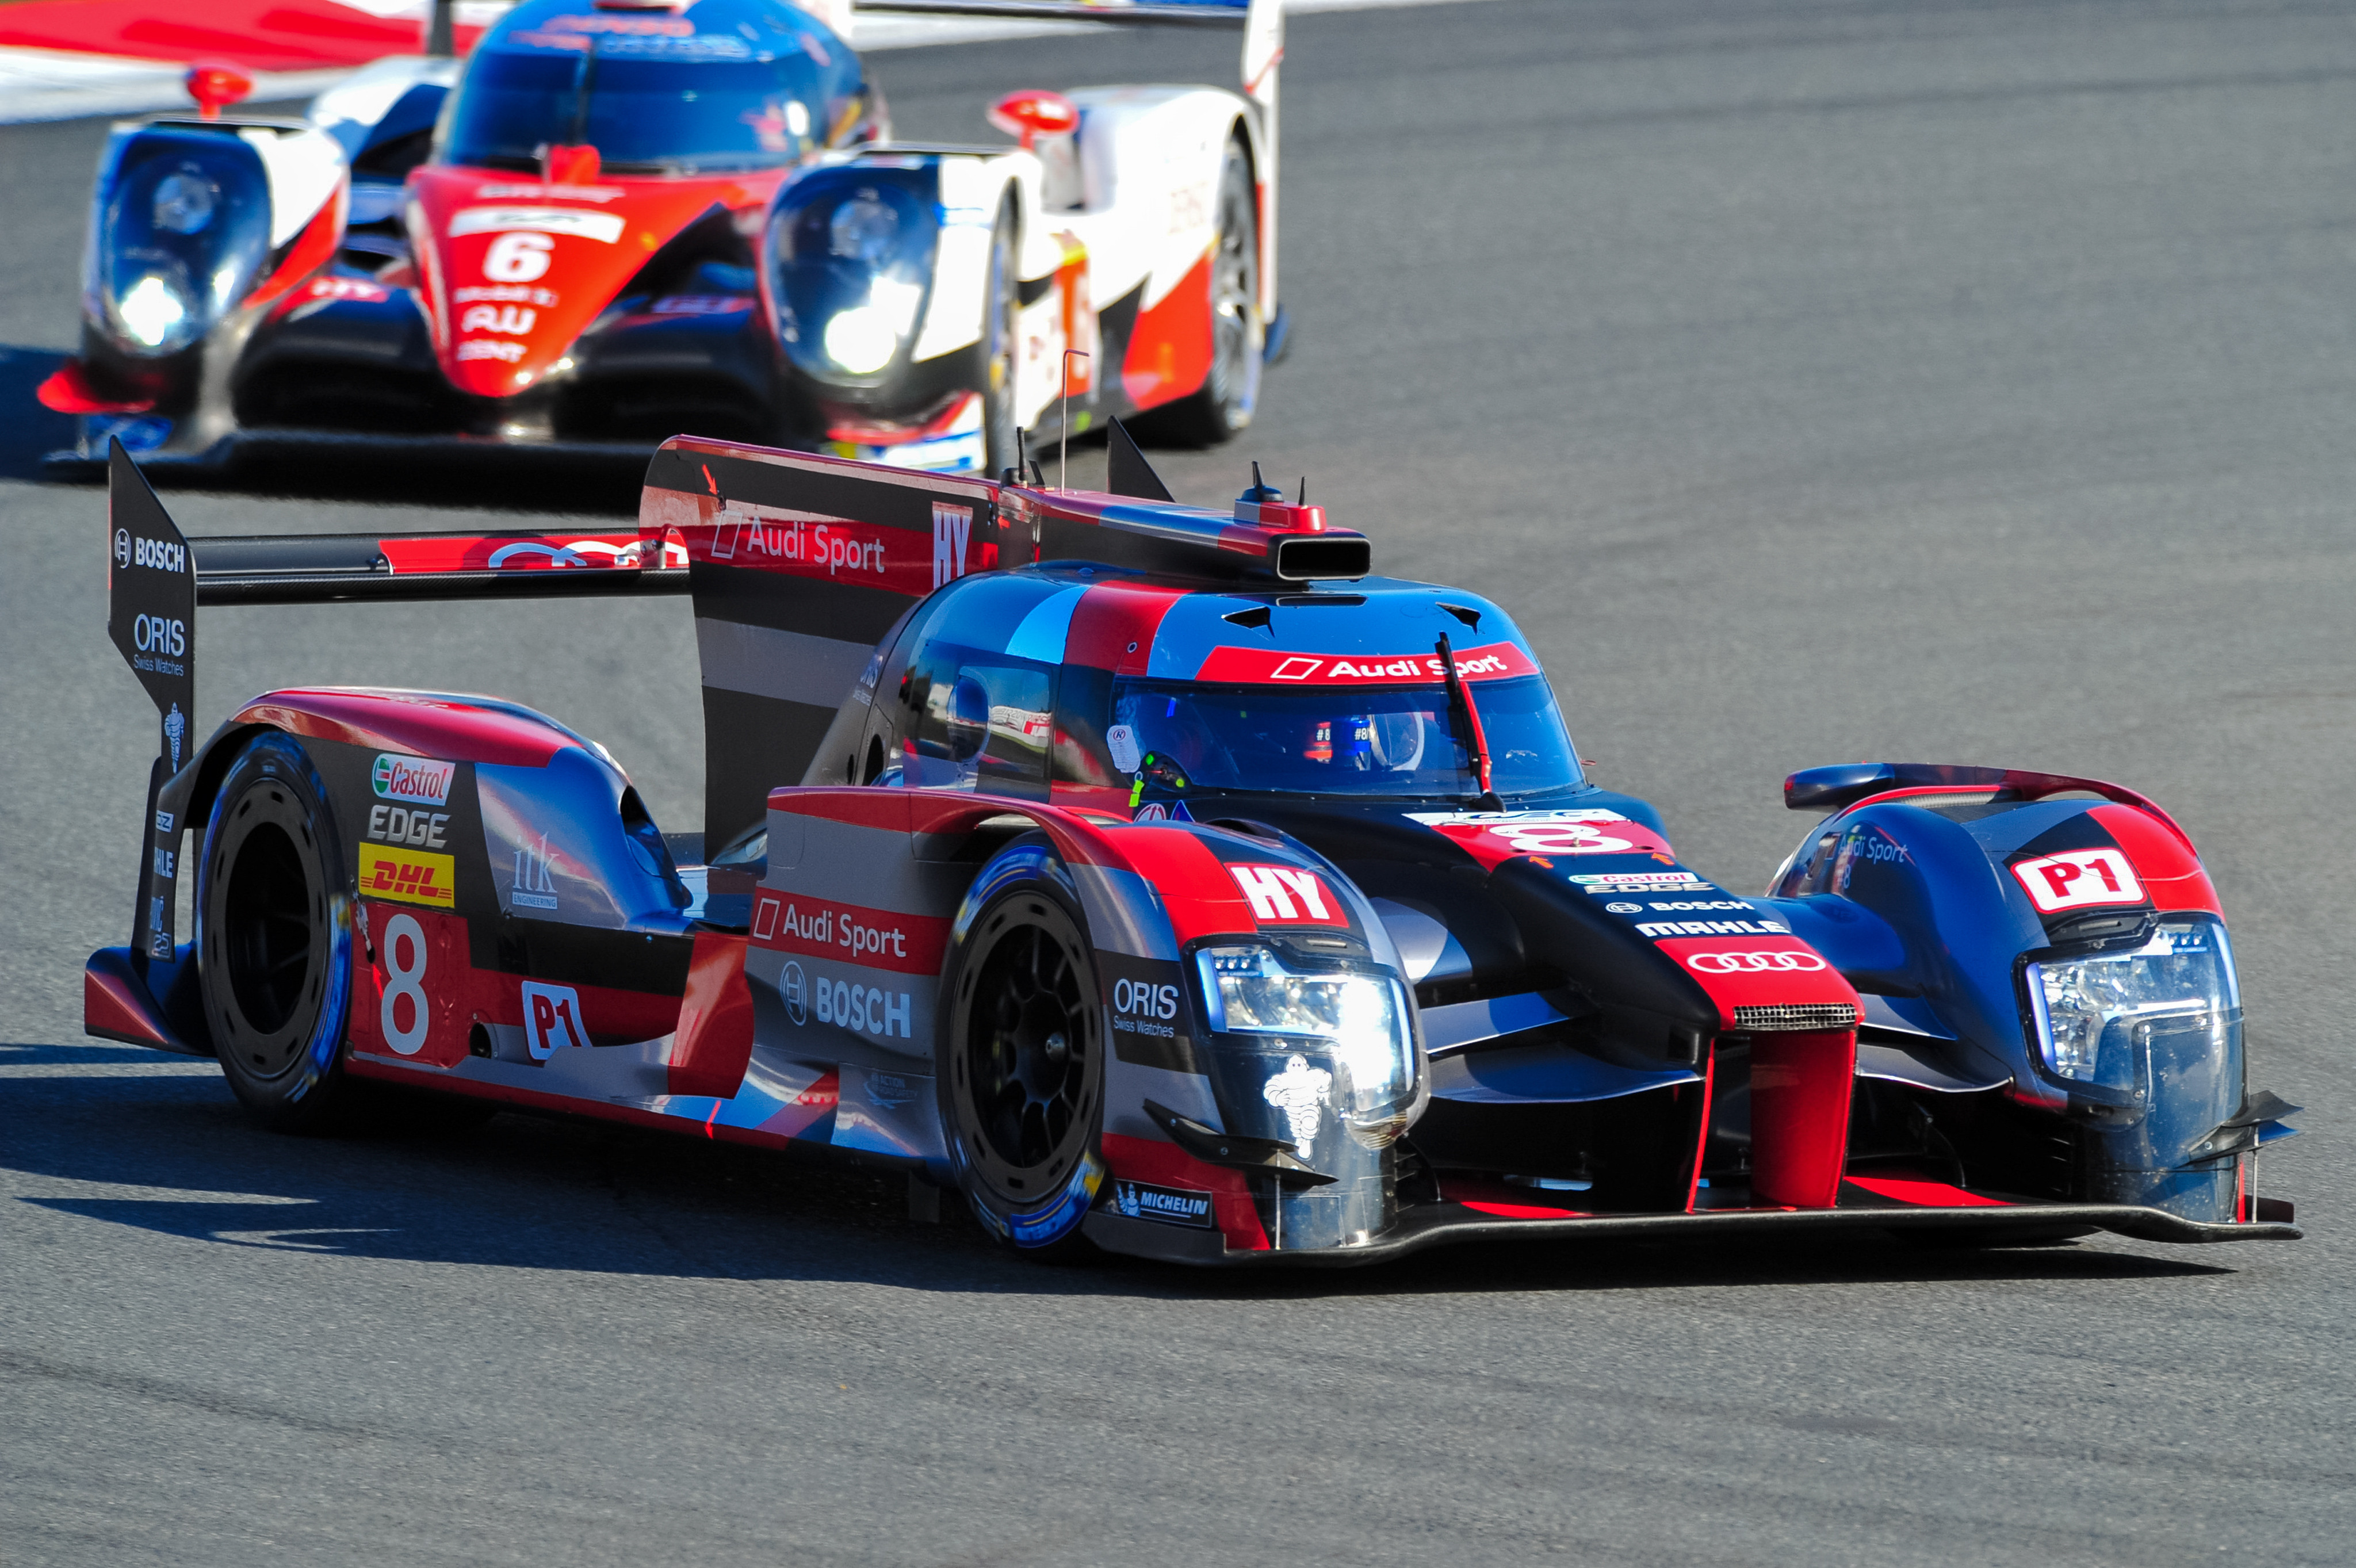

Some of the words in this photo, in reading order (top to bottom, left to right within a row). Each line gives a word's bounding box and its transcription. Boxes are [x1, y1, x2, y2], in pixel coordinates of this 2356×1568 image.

[481, 231, 555, 282] 6
[135, 537, 185, 573] BOSCH
[747, 516, 805, 560] Audi
[814, 525, 885, 575] Sport
[933, 511, 971, 589] HY
[134, 613, 185, 657] ORIS
[133, 654, 154, 672] Swiss
[155, 657, 184, 676] Watches
[1328, 660, 1421, 677] Audi
[1426, 655, 1508, 678] Sport
[390, 762, 448, 799] Castrol
[367, 805, 452, 849] EDGE
[1489, 823, 1633, 852] 8
[512, 832, 560, 893] itk
[1838, 833, 1865, 857] Audi
[1866, 836, 1908, 865] Sport
[372, 860, 439, 897] DHL
[1230, 867, 1330, 920] HY
[1584, 882, 1716, 894] EDGE
[1602, 874, 1686, 883] Castrol
[2038, 858, 2122, 898] P1
[513, 894, 556, 908] ENGINEERING
[1648, 901, 1755, 912] BOSCH
[783, 904, 832, 943] Audi
[839, 913, 907, 957] Sport
[1635, 920, 1791, 937] MAHLE
[381, 914, 429, 1055] 8
[1114, 978, 1179, 1019] ORIS
[531, 993, 581, 1049] P1
[817, 977, 911, 1038] BOSCH
[1114, 1015, 1135, 1032] Swiss
[1136, 1020, 1174, 1038] Watches
[1141, 1192, 1208, 1215] MICHELIN
